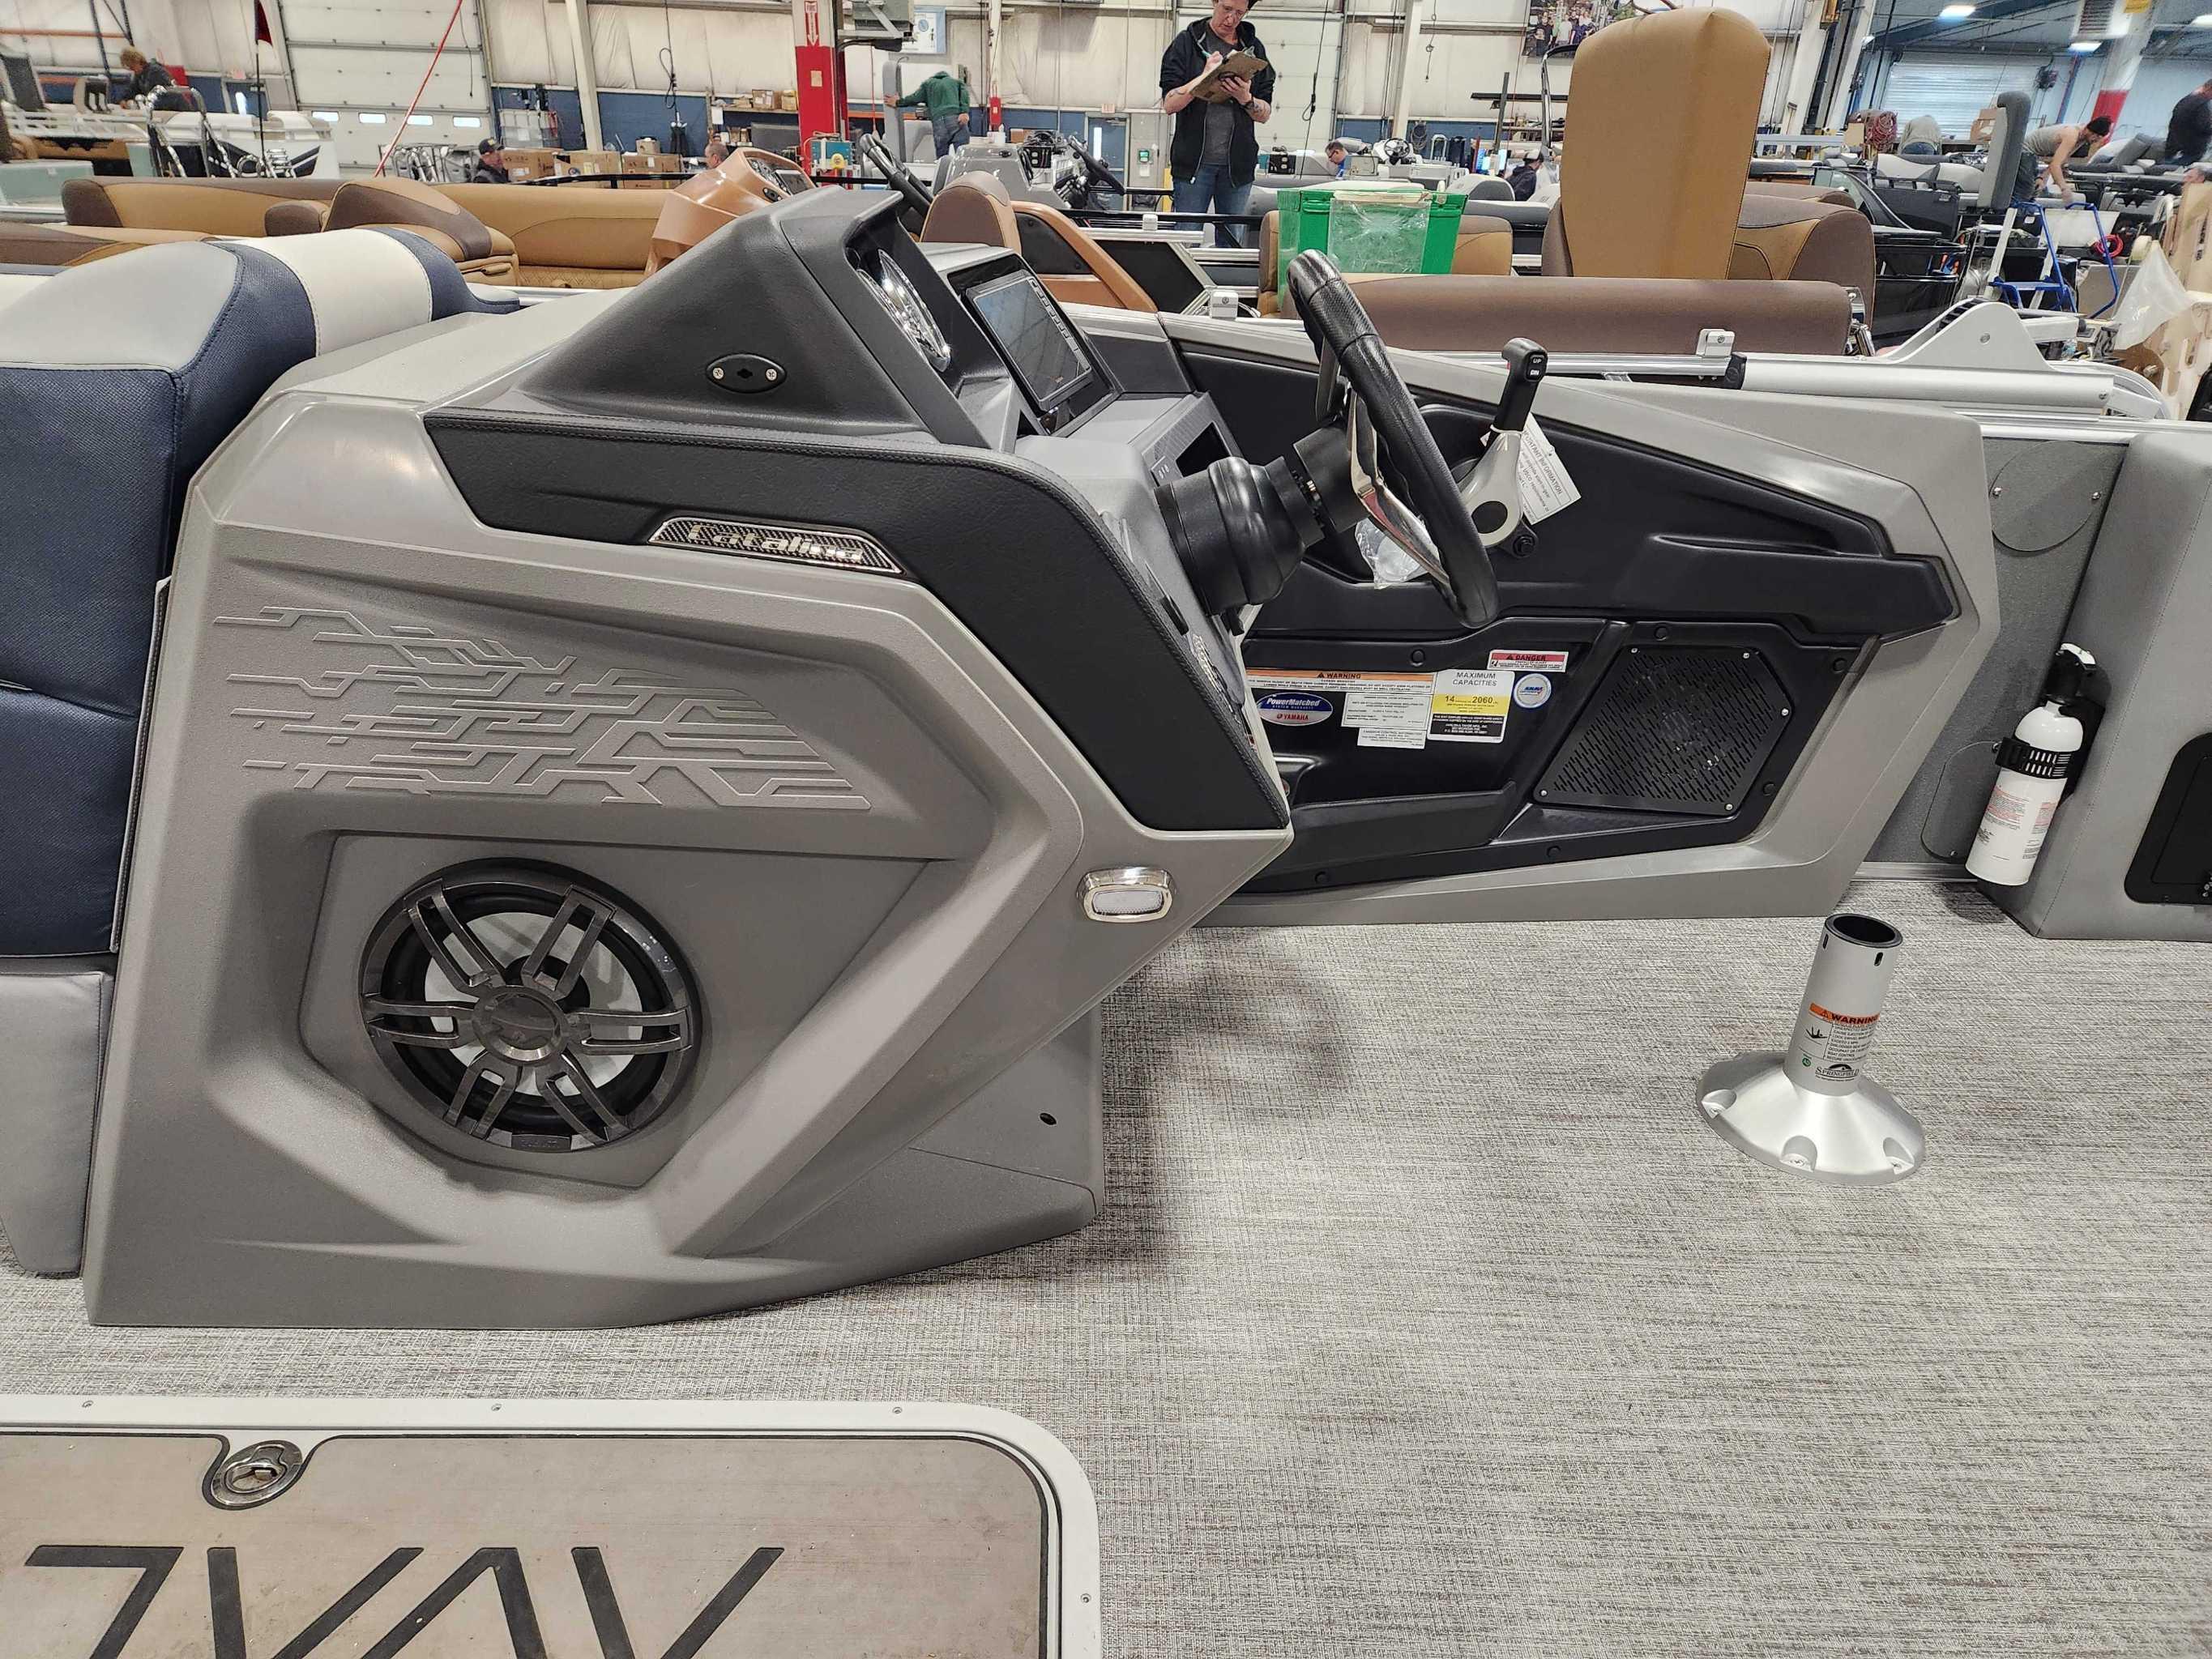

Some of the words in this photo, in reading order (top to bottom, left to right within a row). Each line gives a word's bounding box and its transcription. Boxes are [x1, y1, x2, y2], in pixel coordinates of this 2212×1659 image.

[1523, 430, 1542, 458] MPORTANT
[688, 524, 862, 563] Catalina
[1456, 672, 1496, 680] MAXIMUM
[1452, 679, 1497, 687] CAPACITIES
[1266, 697, 1322, 706] PowerMatched
[1472, 696, 1493, 704] 2060
[1815, 1066, 1860, 1077] SPRINGFIELD
